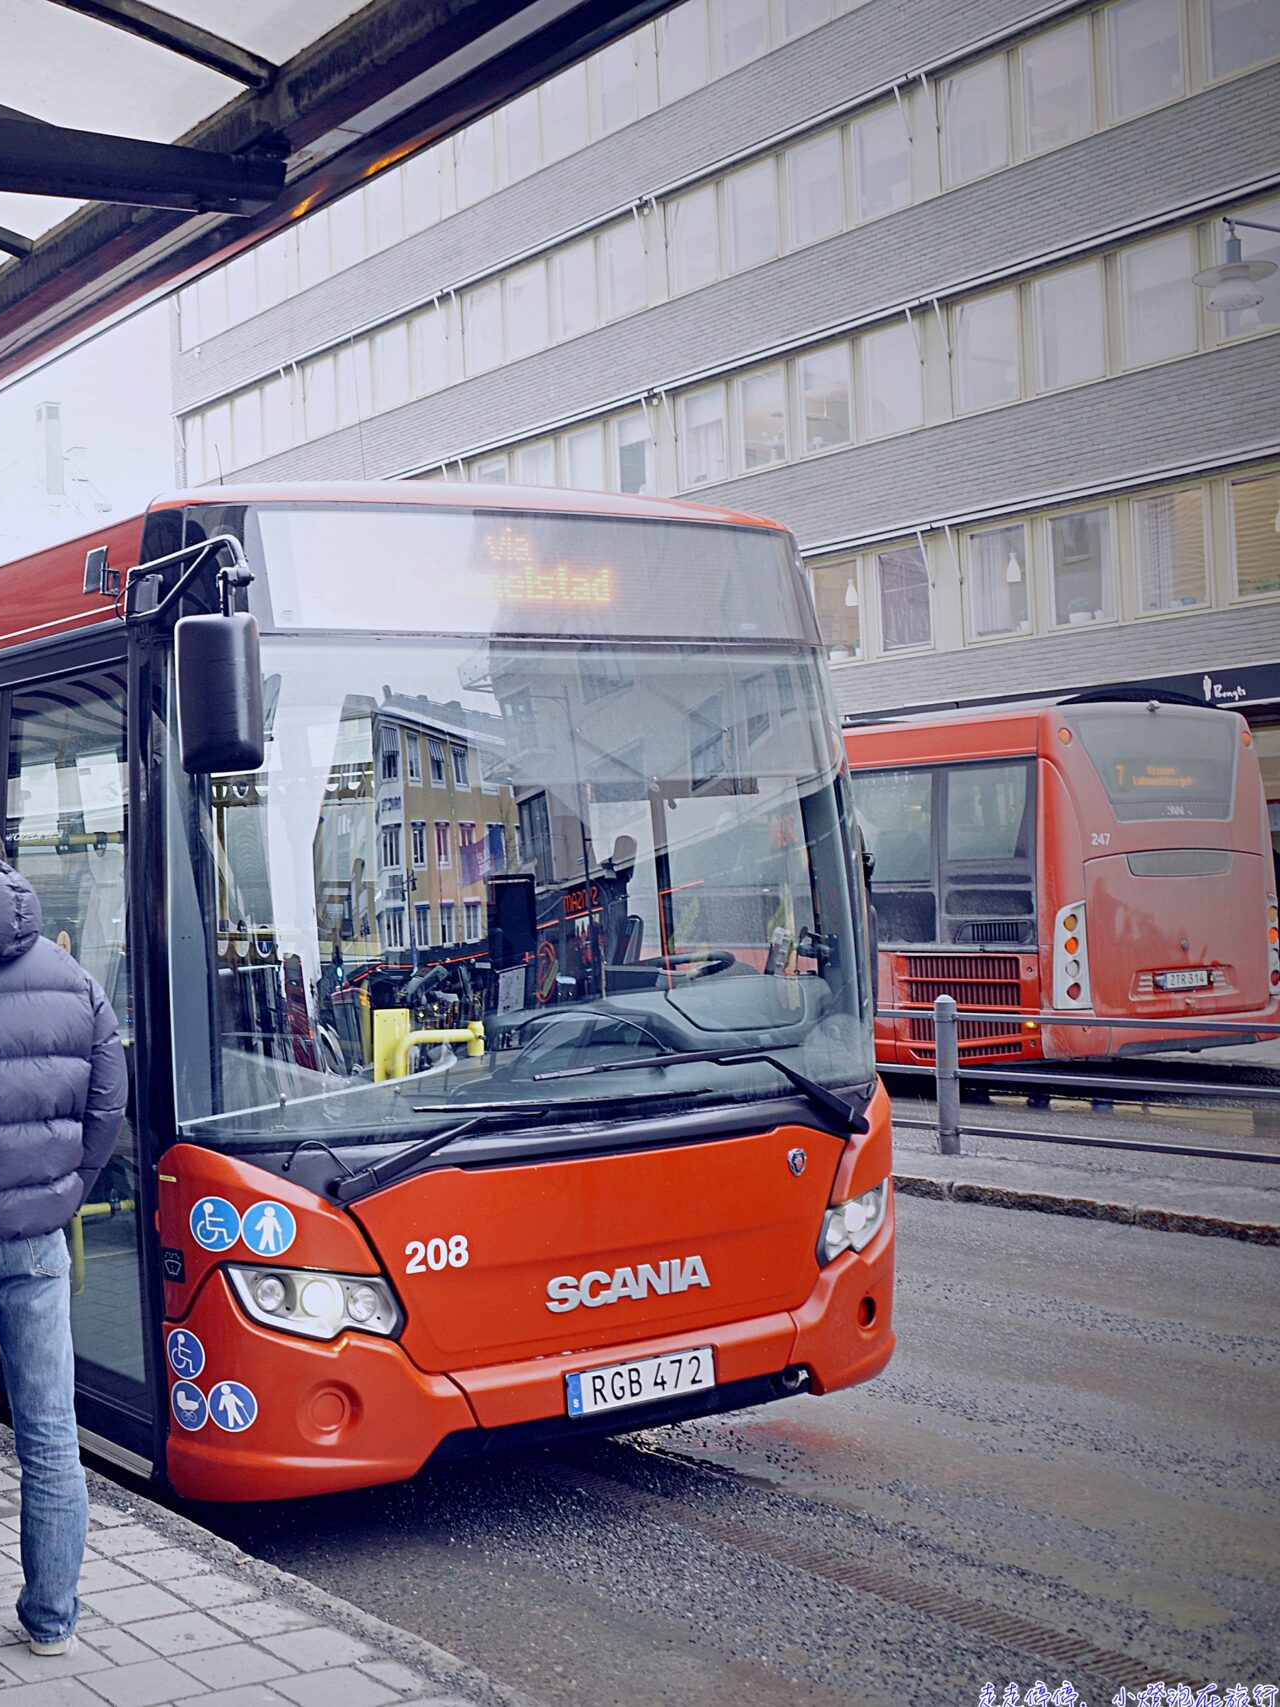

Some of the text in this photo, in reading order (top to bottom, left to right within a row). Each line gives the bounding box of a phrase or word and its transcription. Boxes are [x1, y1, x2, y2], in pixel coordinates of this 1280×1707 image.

[1091, 833, 1110, 846] 247
[1170, 973, 1204, 986] ZTR 314
[404, 1234, 469, 1275] 208
[545, 1255, 711, 1314] SCANIA
[592, 1355, 702, 1405] RGB 472
[573, 1399, 580, 1408] S
